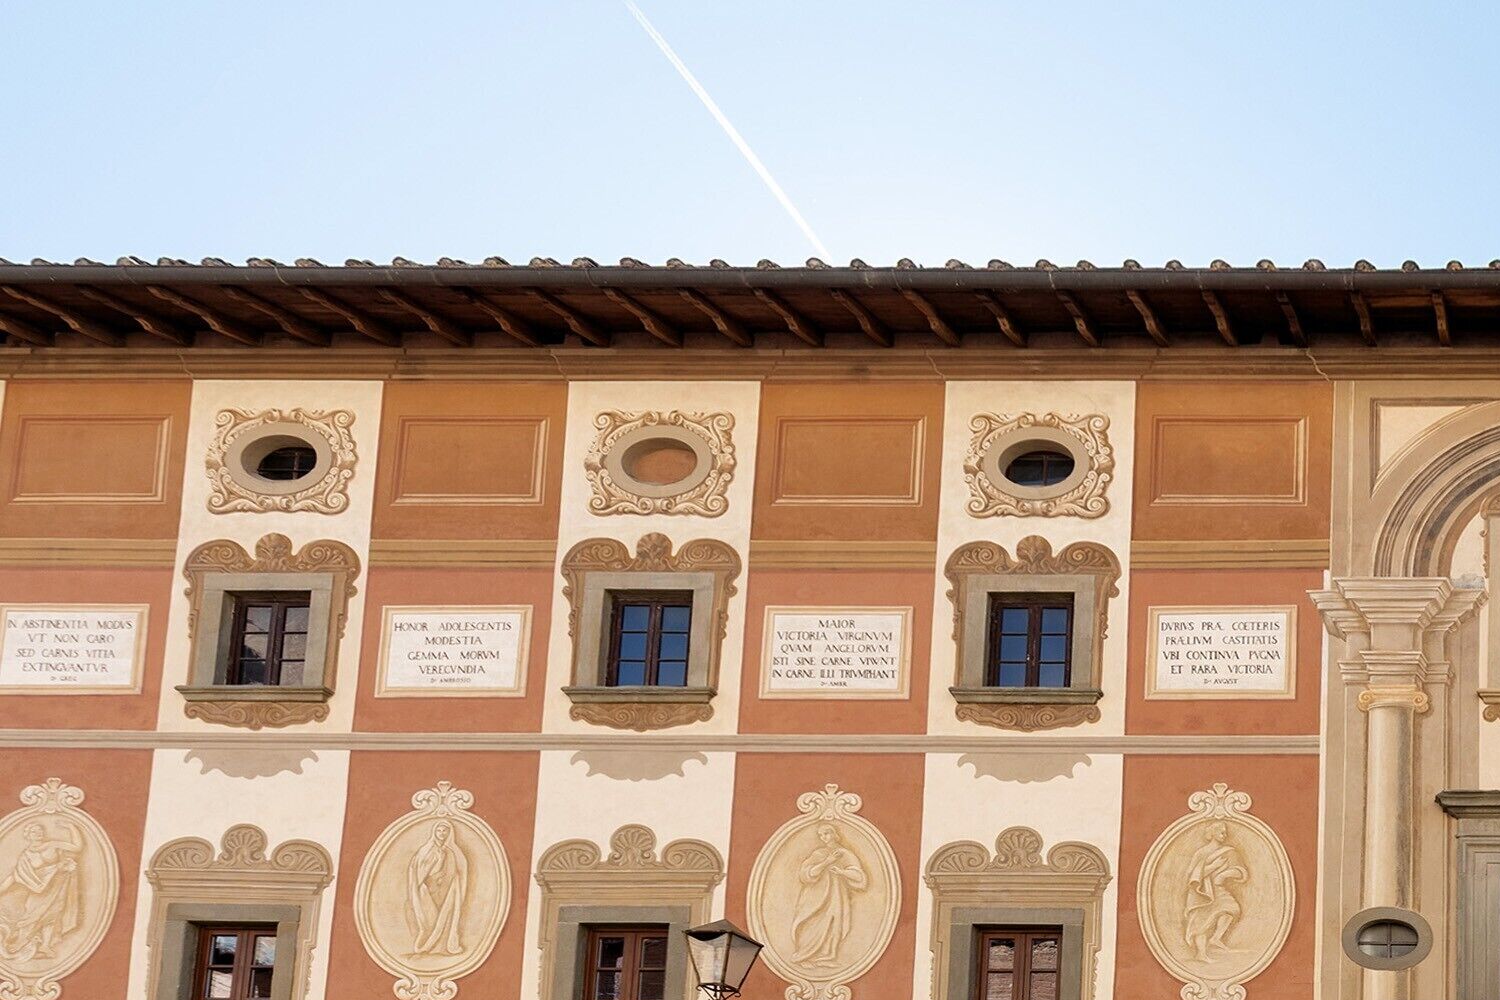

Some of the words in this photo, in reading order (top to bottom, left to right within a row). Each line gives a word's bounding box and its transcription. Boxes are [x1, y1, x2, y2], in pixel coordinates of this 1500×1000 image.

[97, 620, 133, 629] MODVS
[394, 623, 428, 631] HONOR
[818, 620, 856, 629] MAIOR
[1161, 622, 1195, 631] DVRIVS
[28, 633, 47, 643] VT
[54, 634, 79, 643] NON
[86, 634, 115, 643] CARO
[777, 631, 827, 641] VICTORIA
[836, 632, 893, 641] VIRGINVM
[425, 636, 483, 646] MODESTIA
[15, 649, 35, 658] SED
[780, 644, 812, 654] QVAM
[824, 644, 890, 653] ANGELORVM
[407, 652, 449, 661] GEMMA
[460, 651, 500, 660] MORVM
[1163, 651, 1180, 660] VBI
[1186, 651, 1240, 660] CONTINVA
[1249, 651, 1281, 660] PVGNA
[794, 657, 816, 666] SINE
[821, 657, 852, 666] CARNE
[419, 665, 486, 675] VERECVNDIA
[772, 669, 782, 678] IN
[786, 670, 816, 678] CARNE
[1171, 665, 1183, 674] ET
[1191, 665, 1218, 674] RARA
[1228, 665, 1273, 674] VICTORIA
